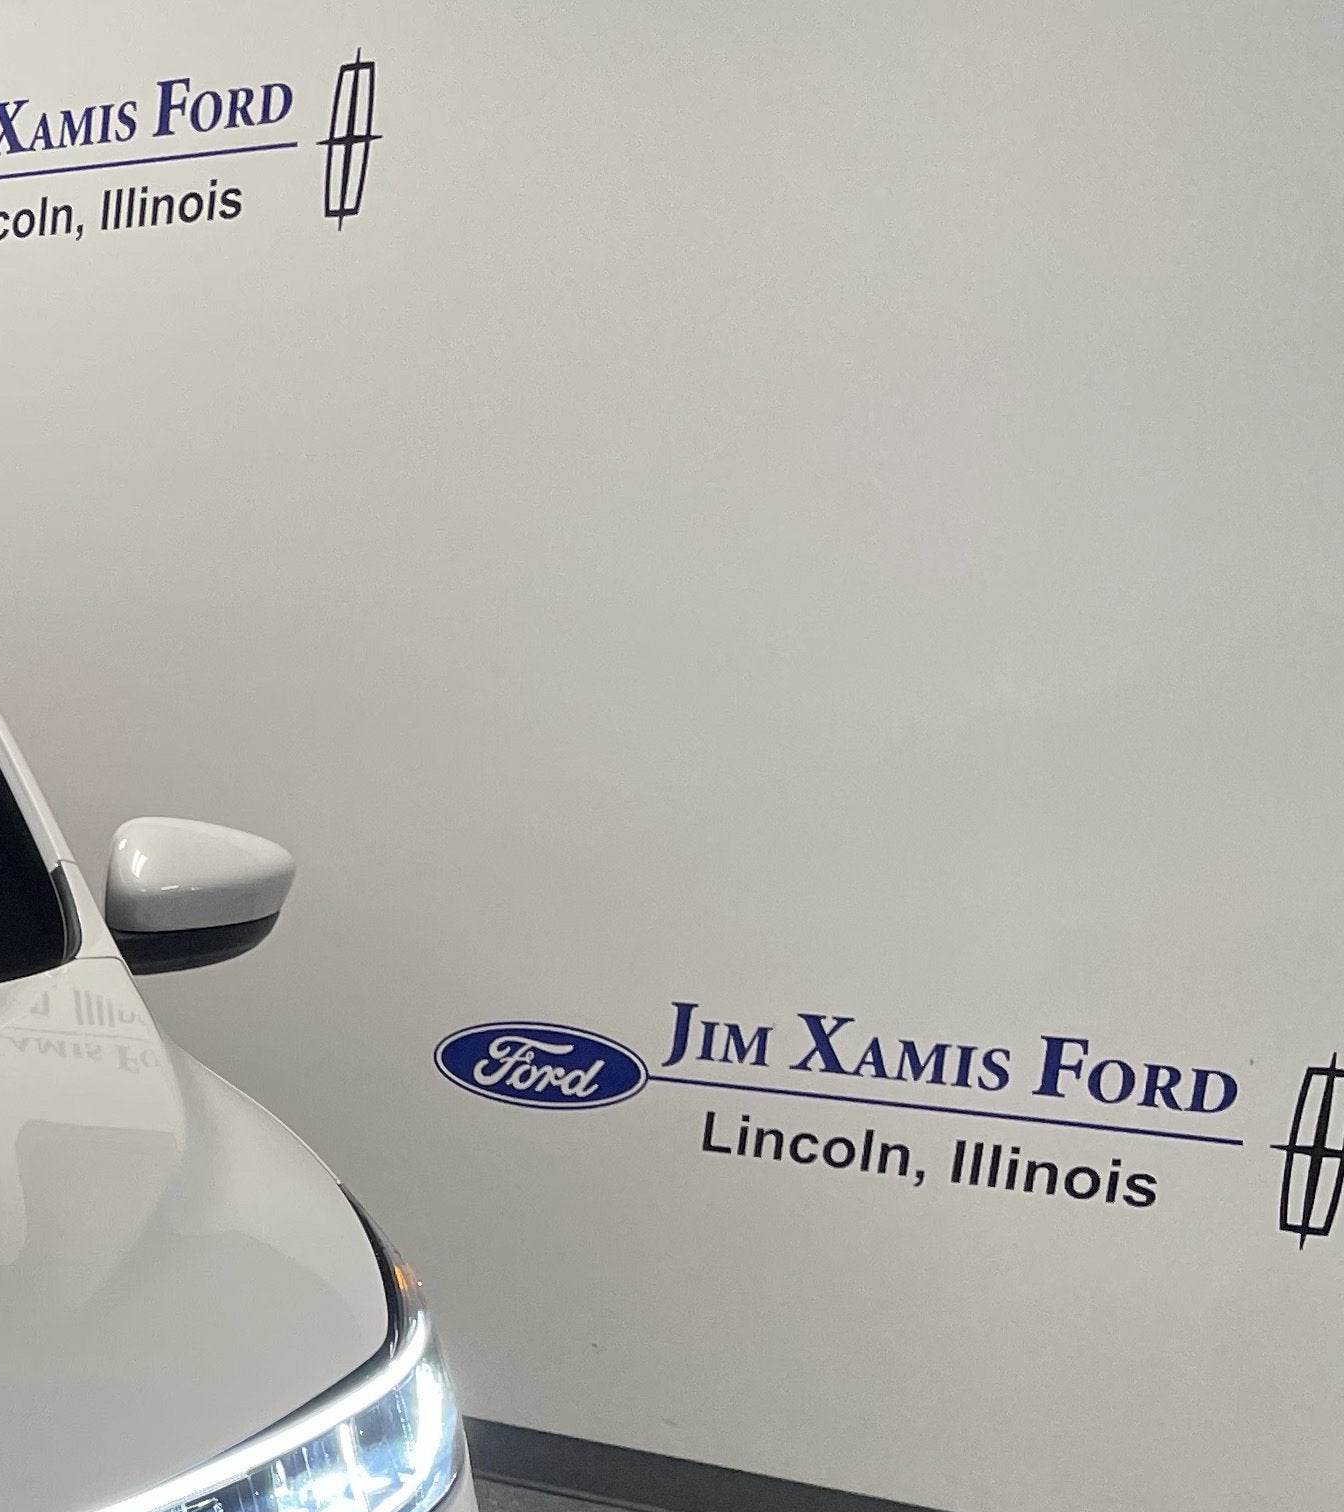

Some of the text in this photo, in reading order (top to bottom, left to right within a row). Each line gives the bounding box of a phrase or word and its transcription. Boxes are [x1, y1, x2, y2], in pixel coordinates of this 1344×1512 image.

[101, 179, 241, 230] Illinois
[474, 1036, 605, 1097] Ford
[703, 1112, 1157, 1207] Lincoln, Illinois
